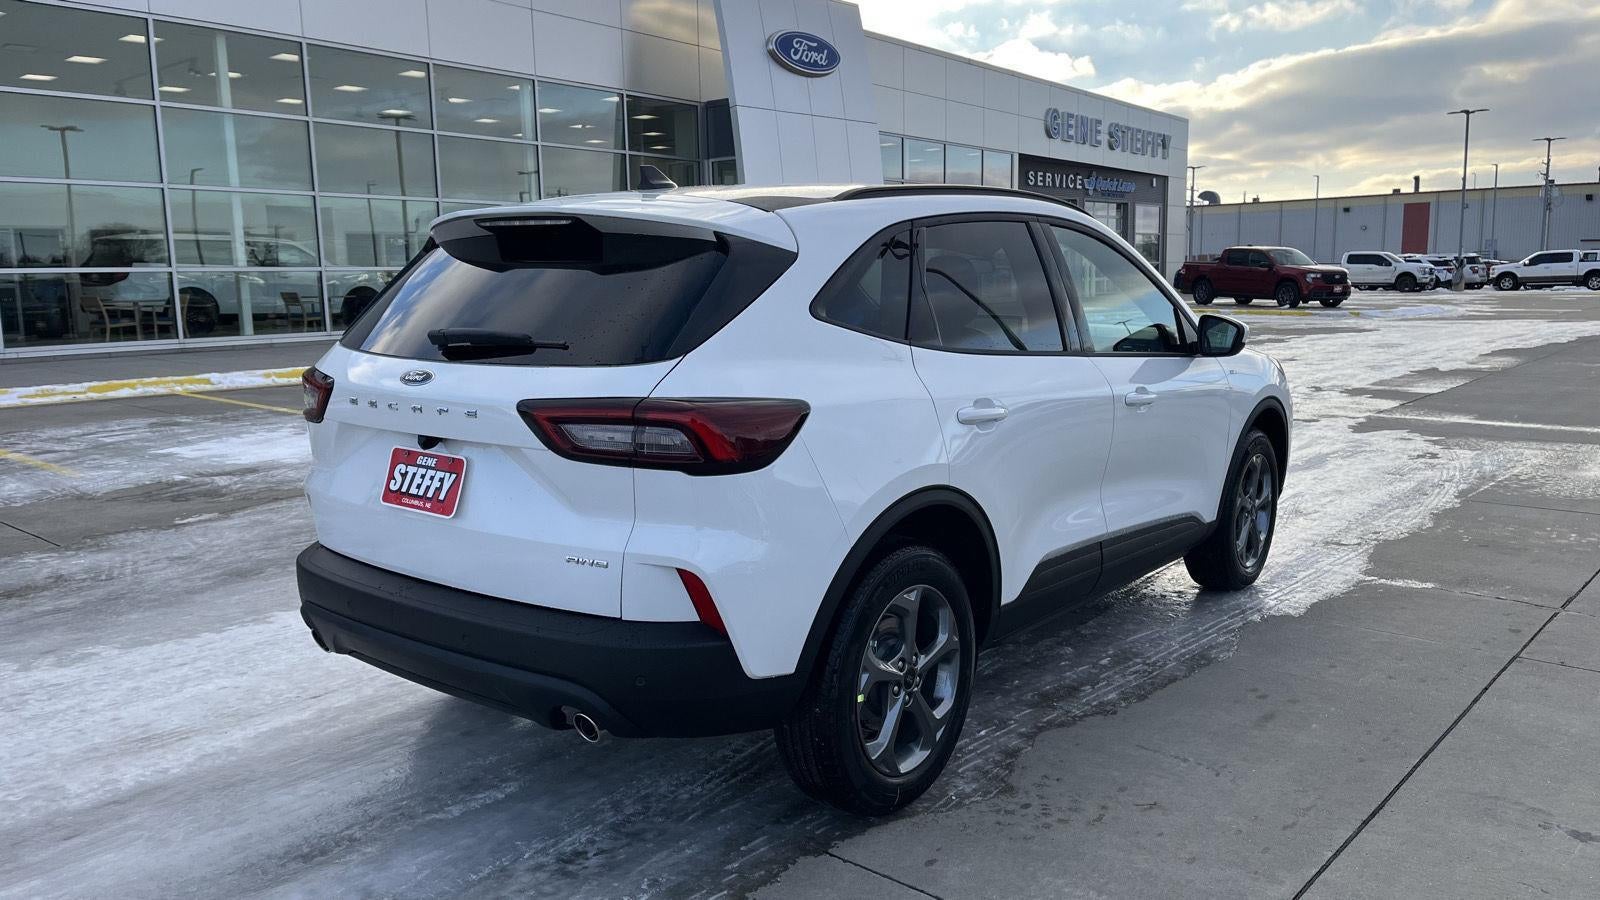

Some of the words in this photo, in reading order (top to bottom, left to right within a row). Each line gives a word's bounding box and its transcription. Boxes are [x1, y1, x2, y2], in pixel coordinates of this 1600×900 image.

[790, 38, 828, 66] Ford
[1044, 107, 1102, 147] GENE
[1108, 122, 1172, 160] STEFFY
[1028, 171, 1083, 189] SERVICE
[349, 396, 478, 419] ESCAPE
[416, 455, 438, 467] GENE
[389, 463, 457, 501] STEFFY
[401, 497, 424, 508] COLUMBUS,
[566, 556, 609, 568] AWD
